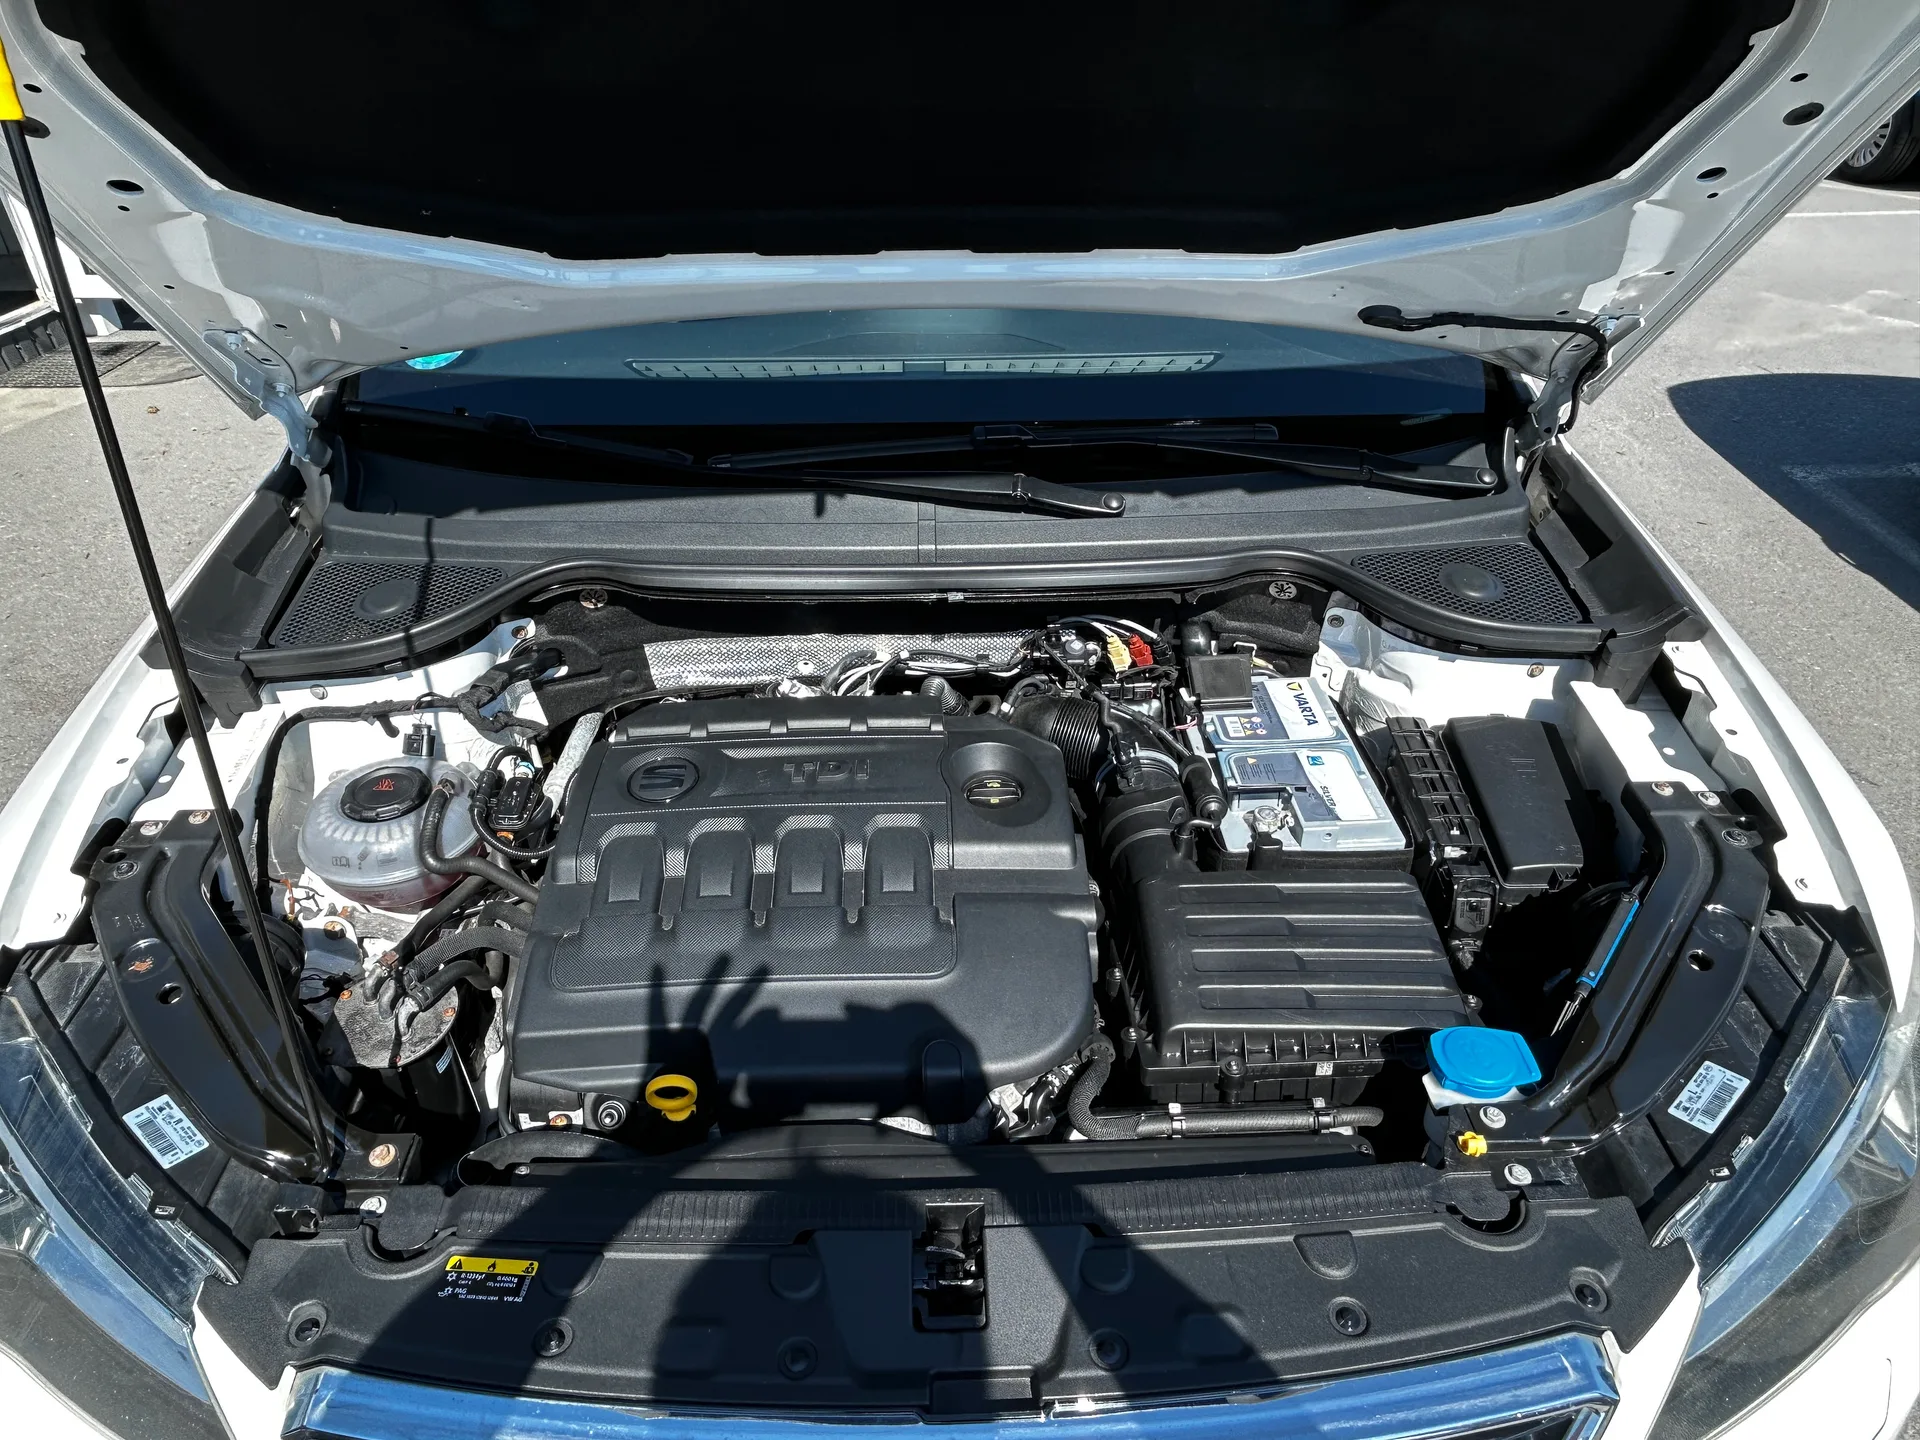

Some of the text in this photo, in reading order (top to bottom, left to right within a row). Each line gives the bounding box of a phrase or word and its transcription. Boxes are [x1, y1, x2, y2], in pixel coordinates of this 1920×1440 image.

[1293, 692, 1319, 726] VARTA
[783, 759, 870, 783] TDI
[1320, 785, 1337, 807] SILVER
